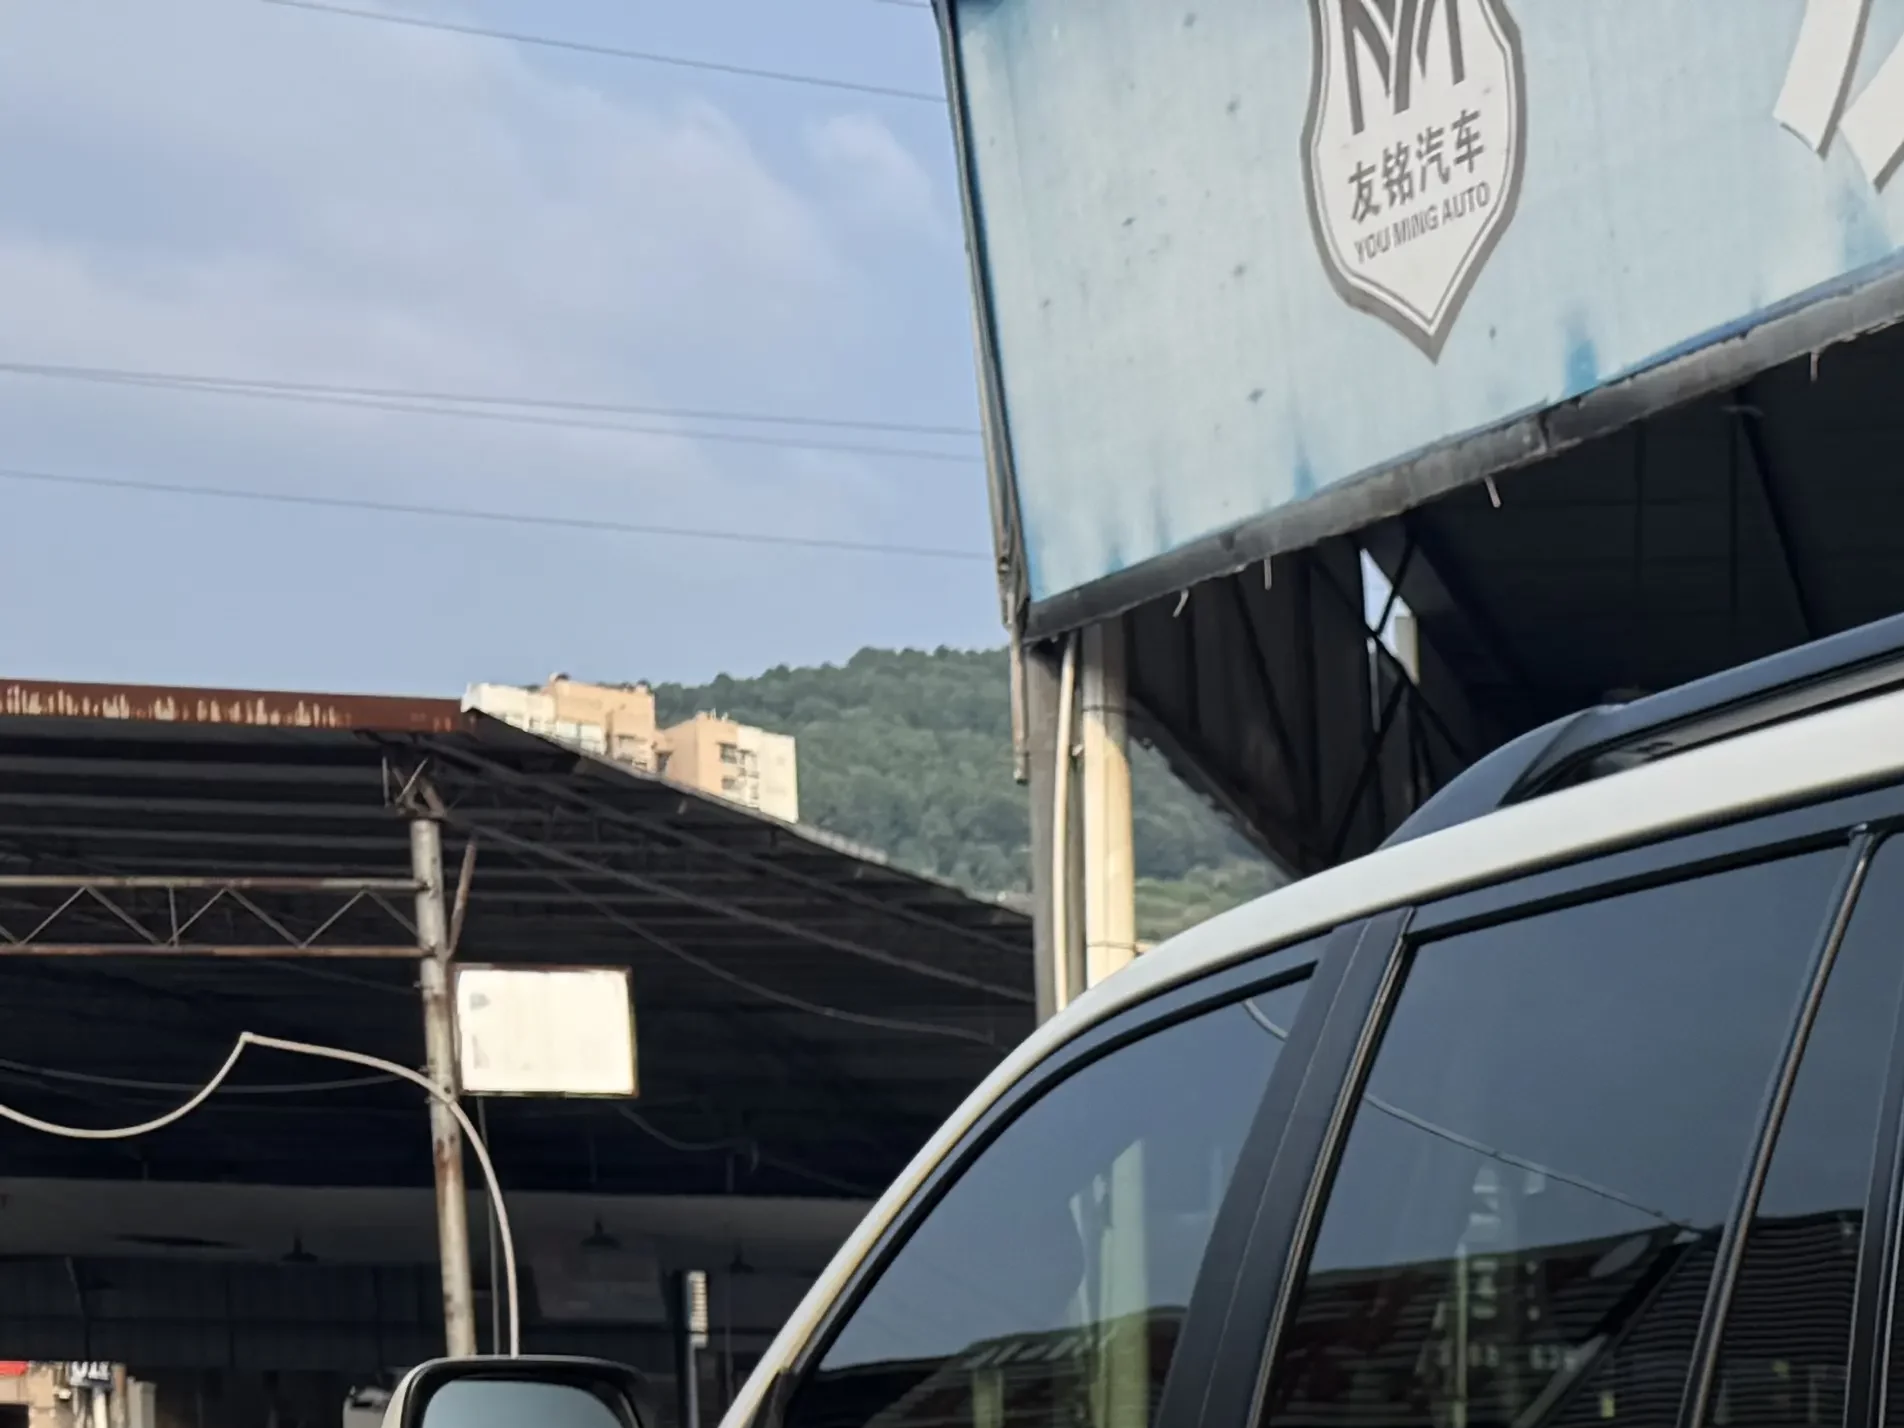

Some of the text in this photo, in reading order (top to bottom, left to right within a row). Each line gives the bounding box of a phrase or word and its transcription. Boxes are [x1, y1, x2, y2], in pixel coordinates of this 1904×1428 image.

[1347, 107, 1487, 224] 友铭汽车
[1353, 181, 1493, 265] YOU MING AUTO
